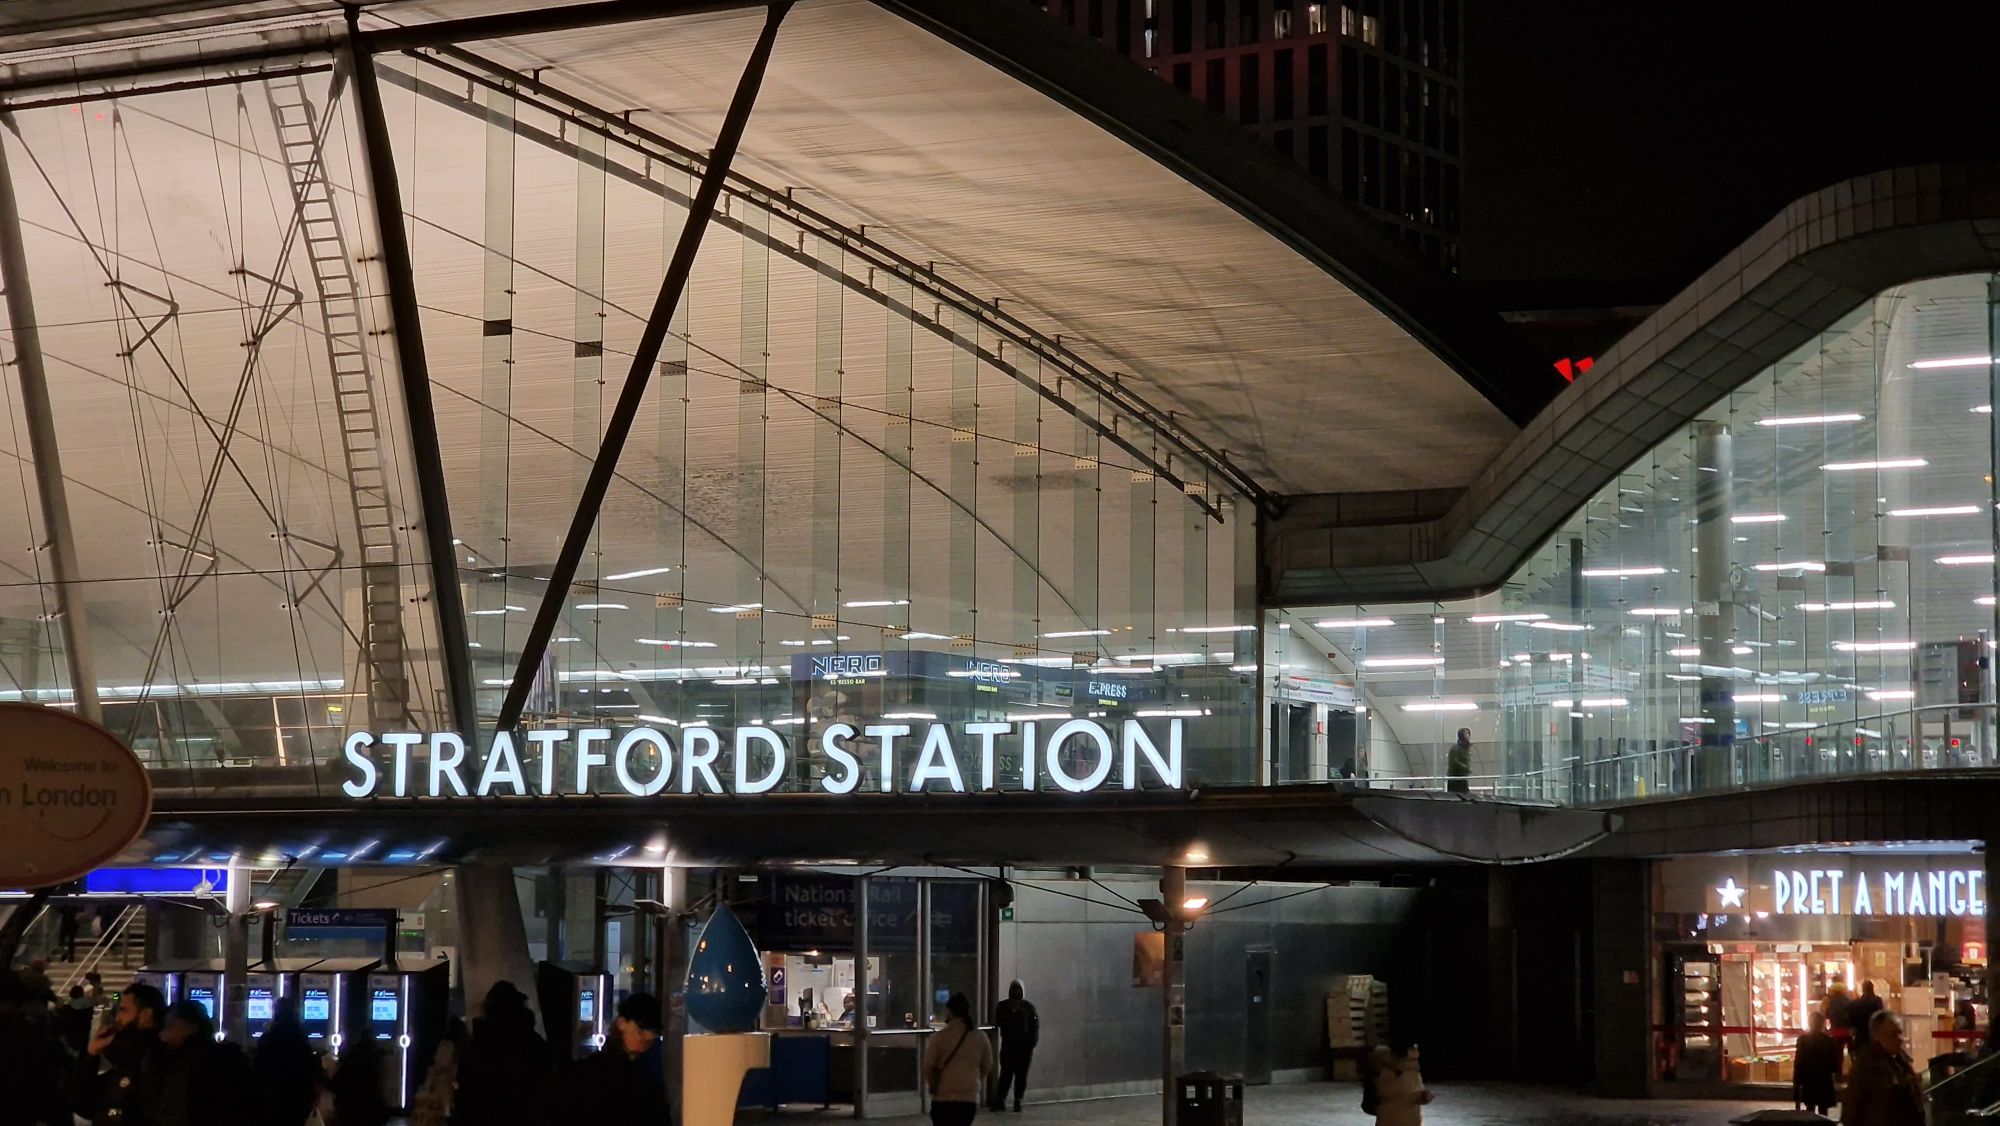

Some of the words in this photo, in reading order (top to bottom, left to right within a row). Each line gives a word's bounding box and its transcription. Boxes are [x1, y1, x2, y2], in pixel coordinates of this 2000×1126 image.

[811, 654, 883, 676] NERO
[966, 660, 1011, 684] NERO
[24, 757, 97, 772] Welcome
[102, 760, 118, 772] to
[342, 726, 786, 798] STRATFORD
[821, 718, 1183, 794] STATION
[22, 782, 118, 806] London
[869, 884, 902, 903] Rail
[1774, 869, 1844, 916] PRET
[1854, 870, 1874, 916] A
[1884, 869, 1984, 917] MANGE
[291, 912, 330, 924] Tickets
[784, 909, 837, 928] ticket
